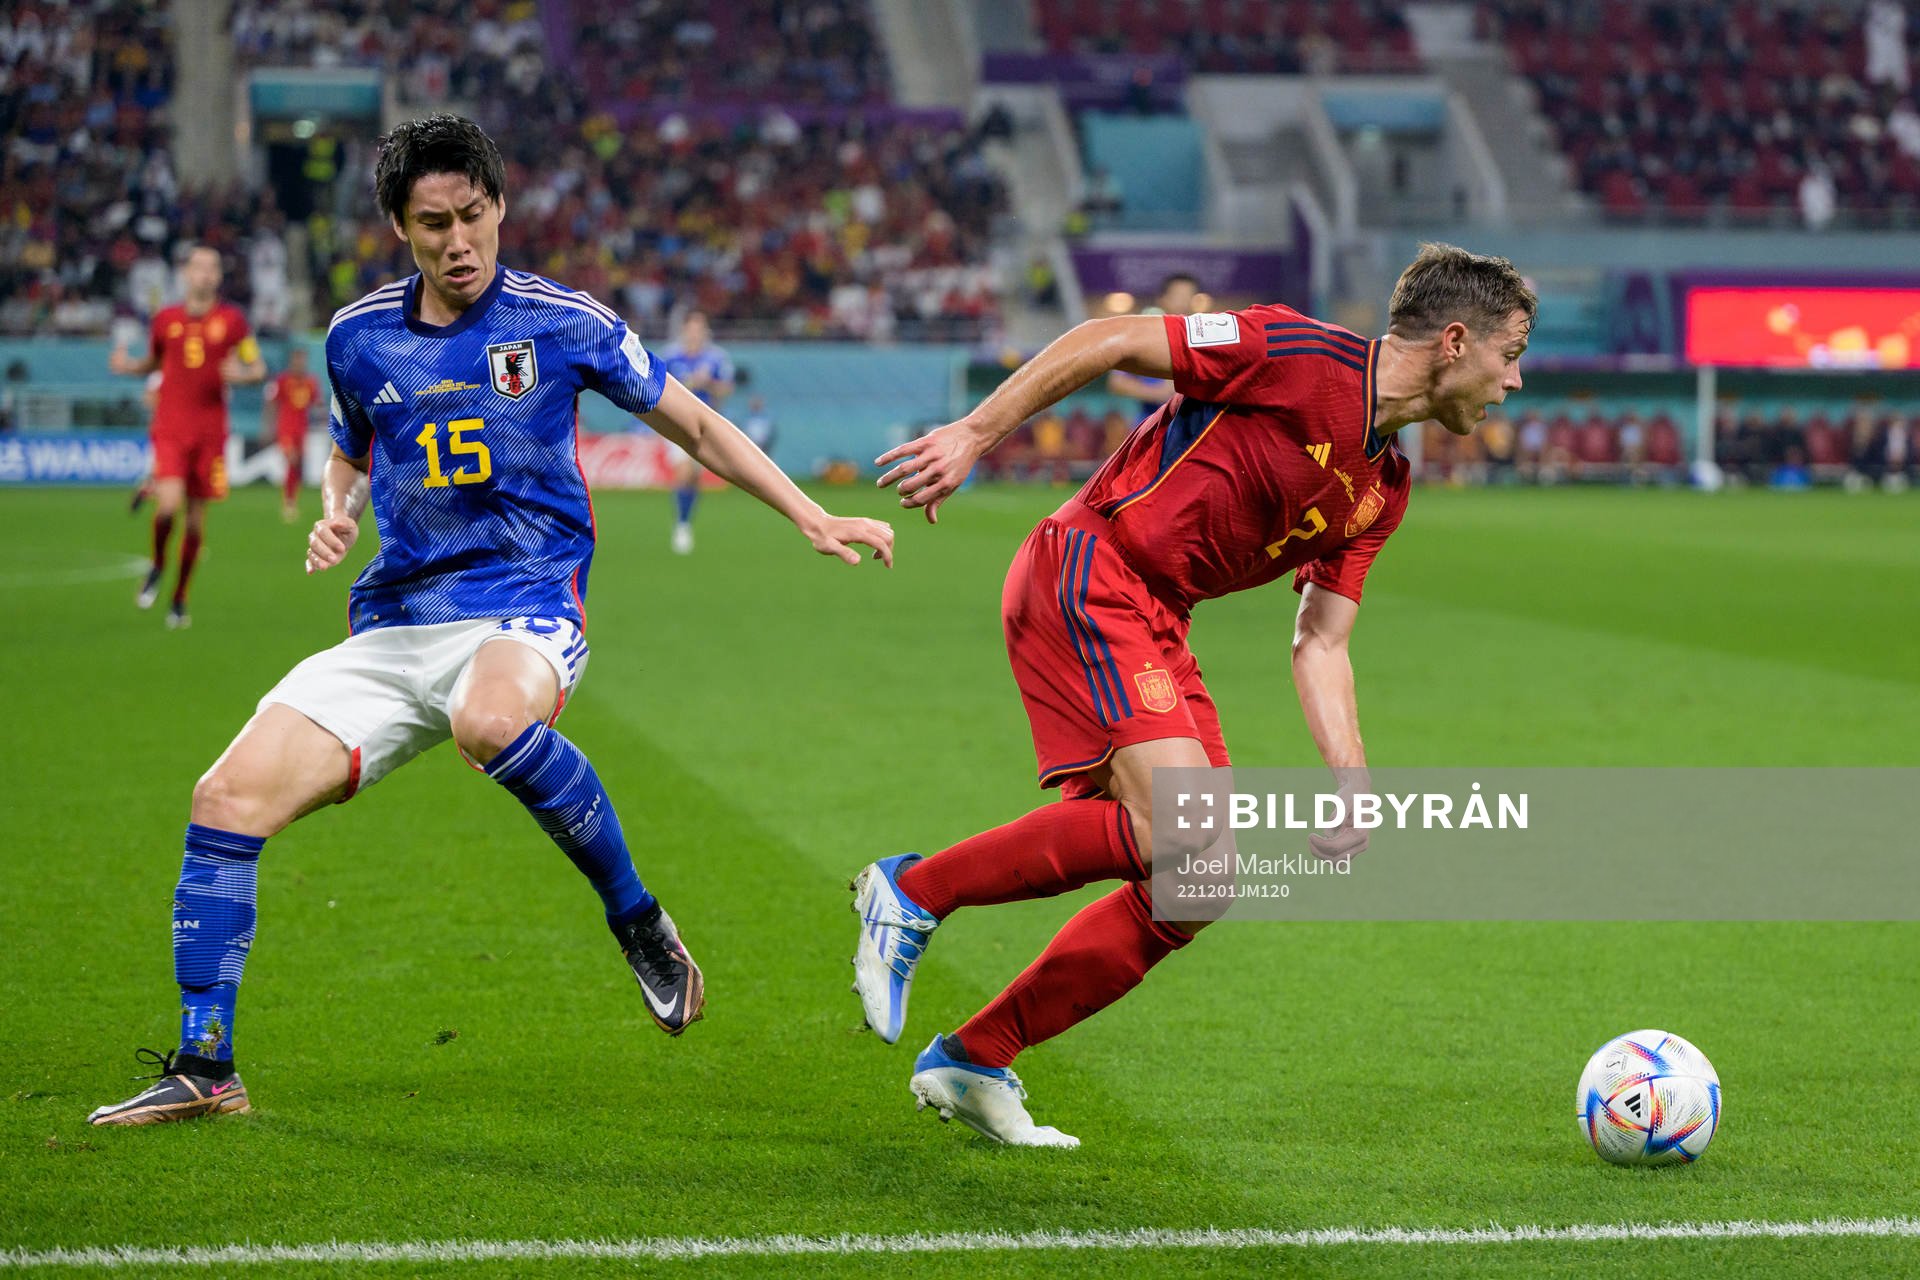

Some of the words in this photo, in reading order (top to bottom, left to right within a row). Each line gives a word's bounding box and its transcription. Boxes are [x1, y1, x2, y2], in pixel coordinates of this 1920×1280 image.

[499, 343, 523, 352] JAPAN
[506, 380, 526, 392] JFA
[415, 418, 492, 488] 15
[1265, 507, 1328, 559] 2
